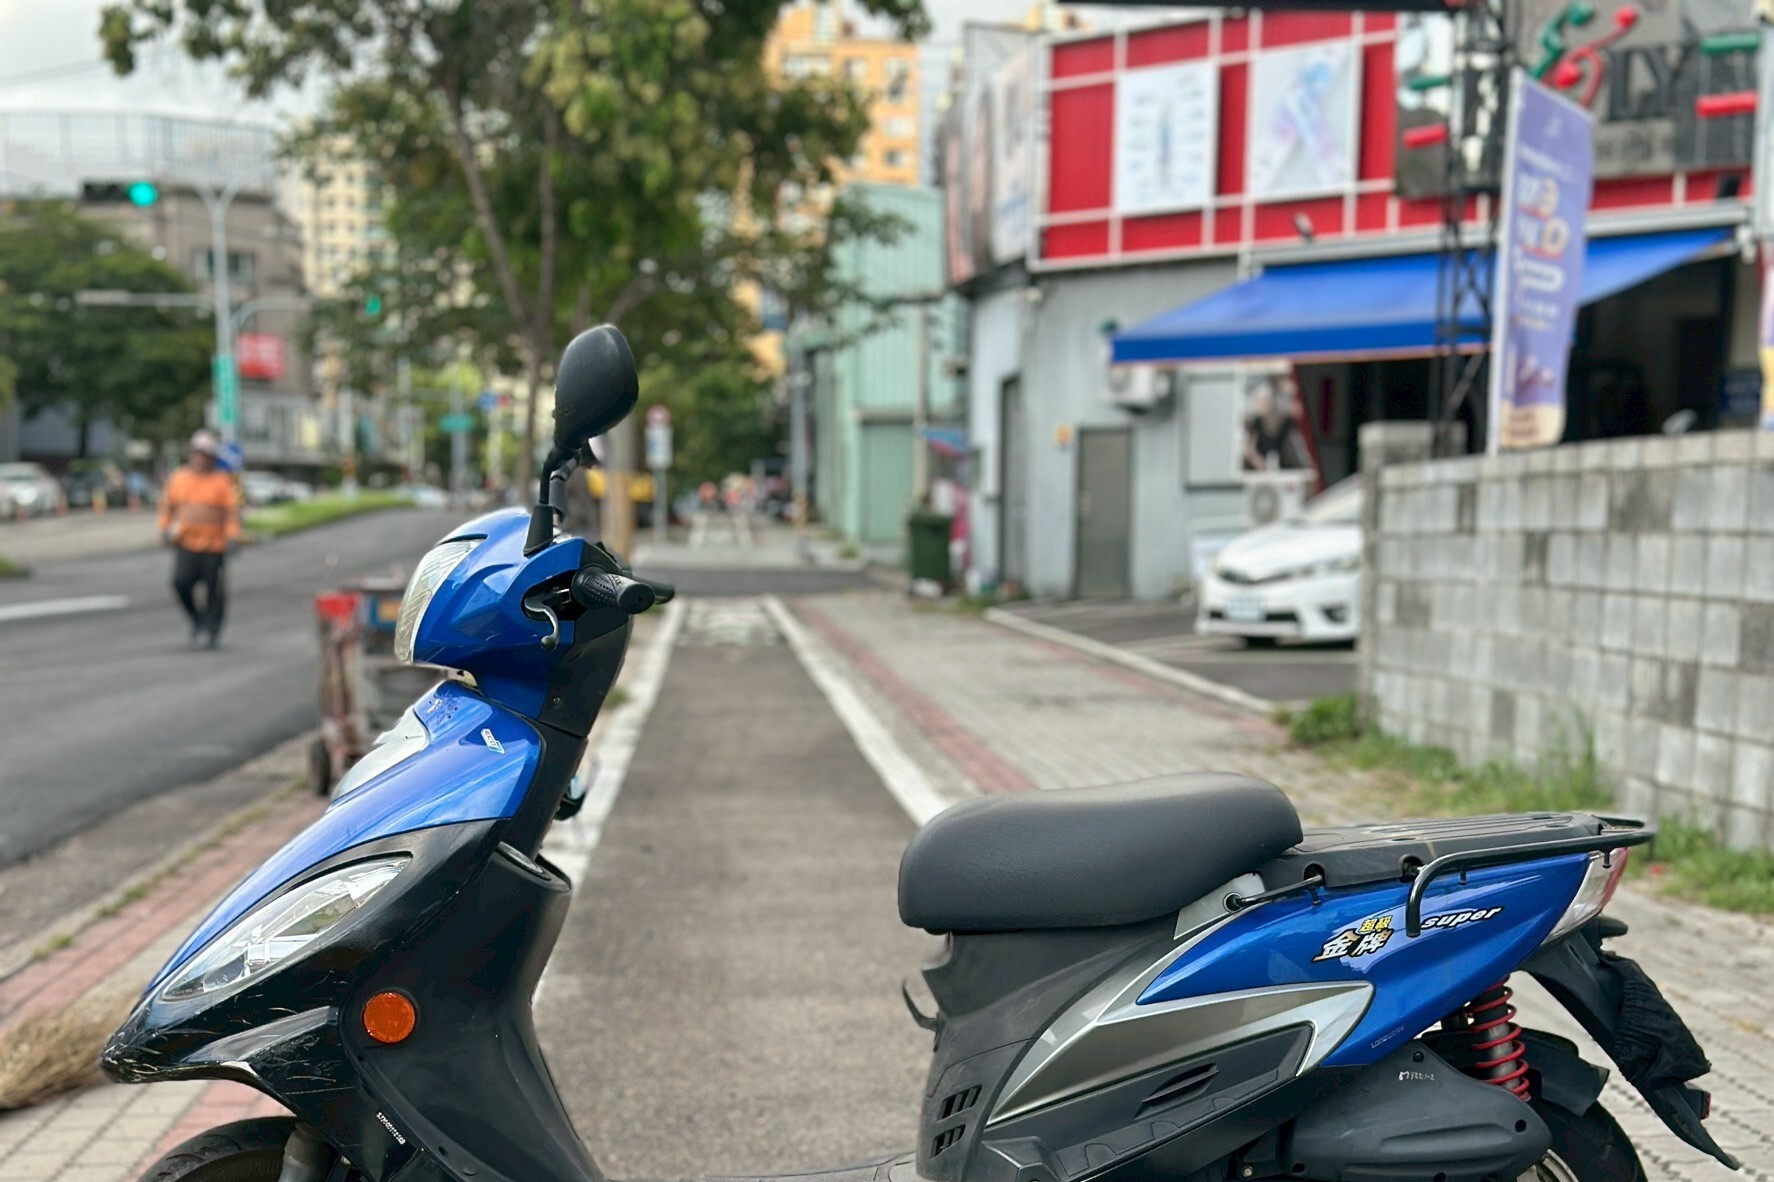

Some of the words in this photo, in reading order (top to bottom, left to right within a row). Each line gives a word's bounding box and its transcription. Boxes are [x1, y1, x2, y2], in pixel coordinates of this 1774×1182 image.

[1359, 915, 1394, 934] 超級
[1421, 906, 1502, 930] super
[1312, 929, 1395, 962] 金牌
